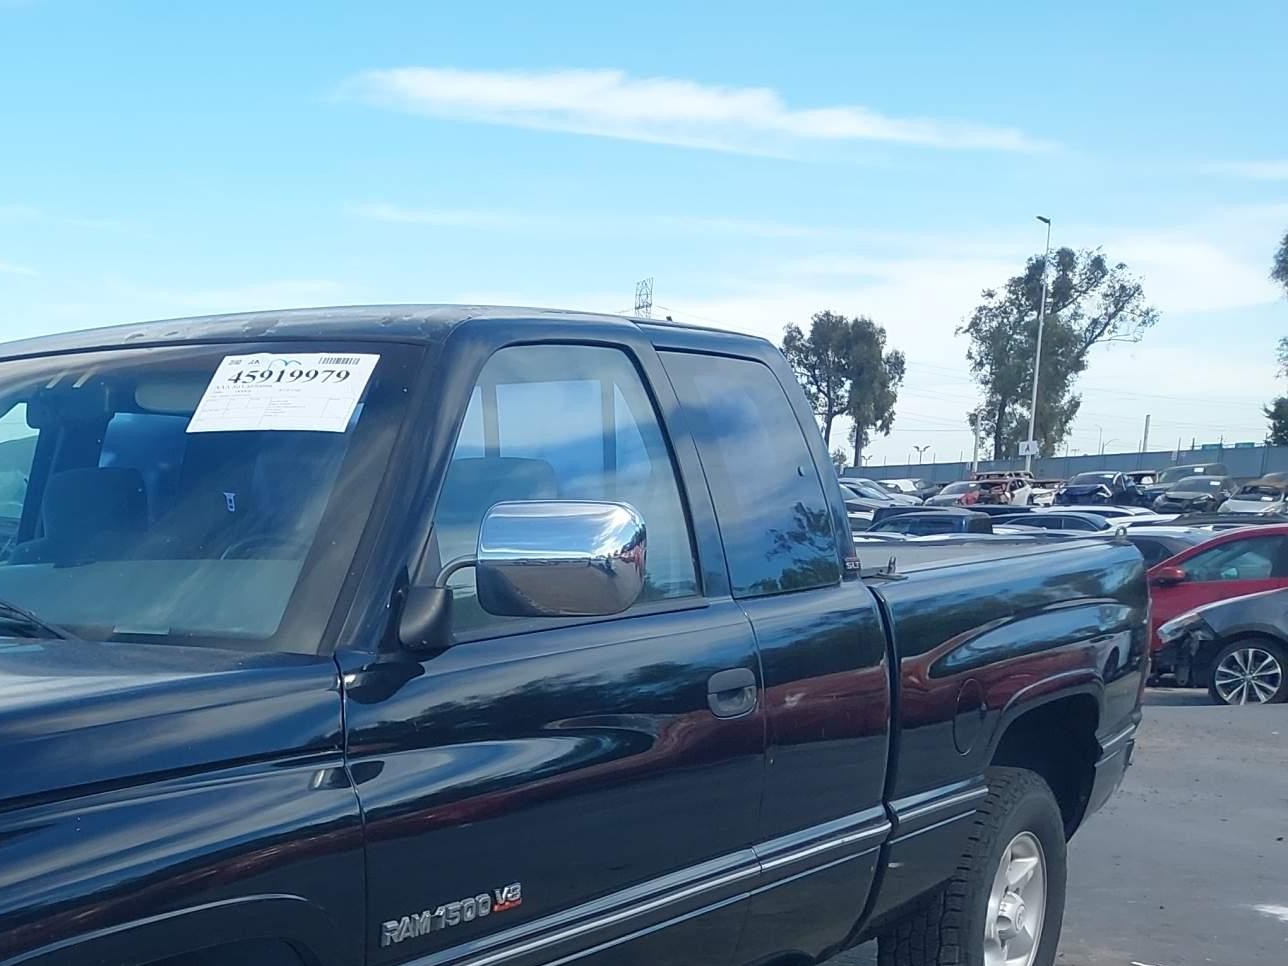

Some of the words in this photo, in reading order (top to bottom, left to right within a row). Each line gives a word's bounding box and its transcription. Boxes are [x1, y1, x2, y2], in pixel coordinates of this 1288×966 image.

[228, 369, 350, 383] 45919979
[382, 911, 430, 947] RAM
[432, 893, 491, 930] 1500
[495, 882, 521, 904] V8
